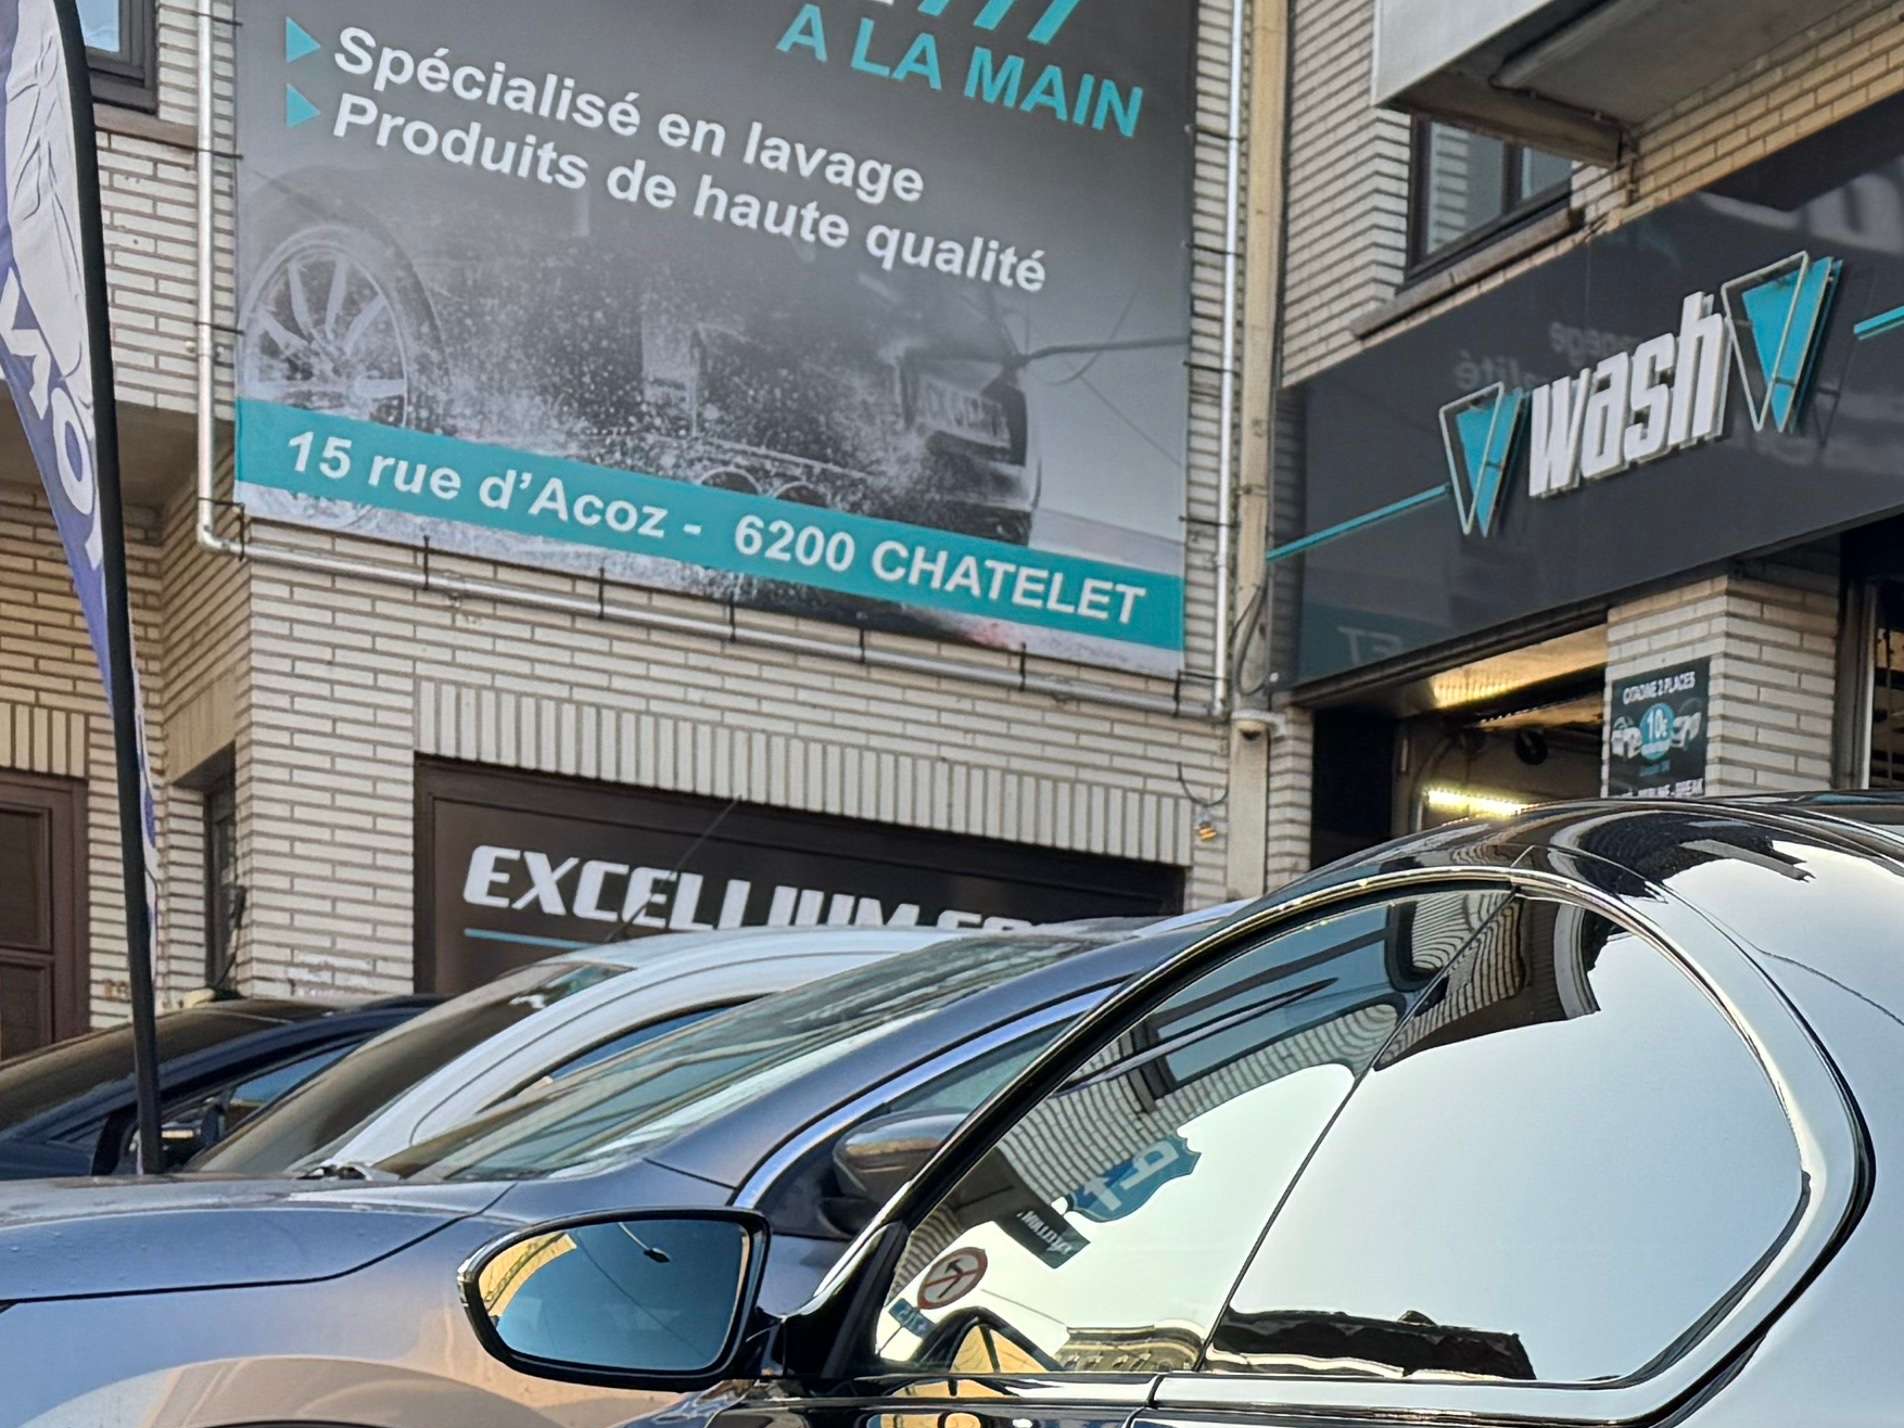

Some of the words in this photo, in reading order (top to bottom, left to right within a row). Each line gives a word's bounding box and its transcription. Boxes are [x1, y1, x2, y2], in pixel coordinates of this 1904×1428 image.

[333, 27, 641, 136] Spécialisé
[658, 111, 724, 158] en
[743, 122, 924, 205] lavage
[777, 8, 827, 61] A
[850, 18, 942, 91] LA
[964, 46, 1143, 138] MAIN
[332, 93, 588, 189] Produits
[606, 160, 677, 209] de
[694, 176, 849, 248] haute
[865, 223, 1045, 292] qualité
[1529, 291, 1728, 497] wash
[287, 430, 352, 480] 15
[368, 452, 461, 500] rue
[478, 469, 666, 539] d'Acoz
[734, 517, 855, 573] 6200
[870, 540, 1146, 625] CHATELET
